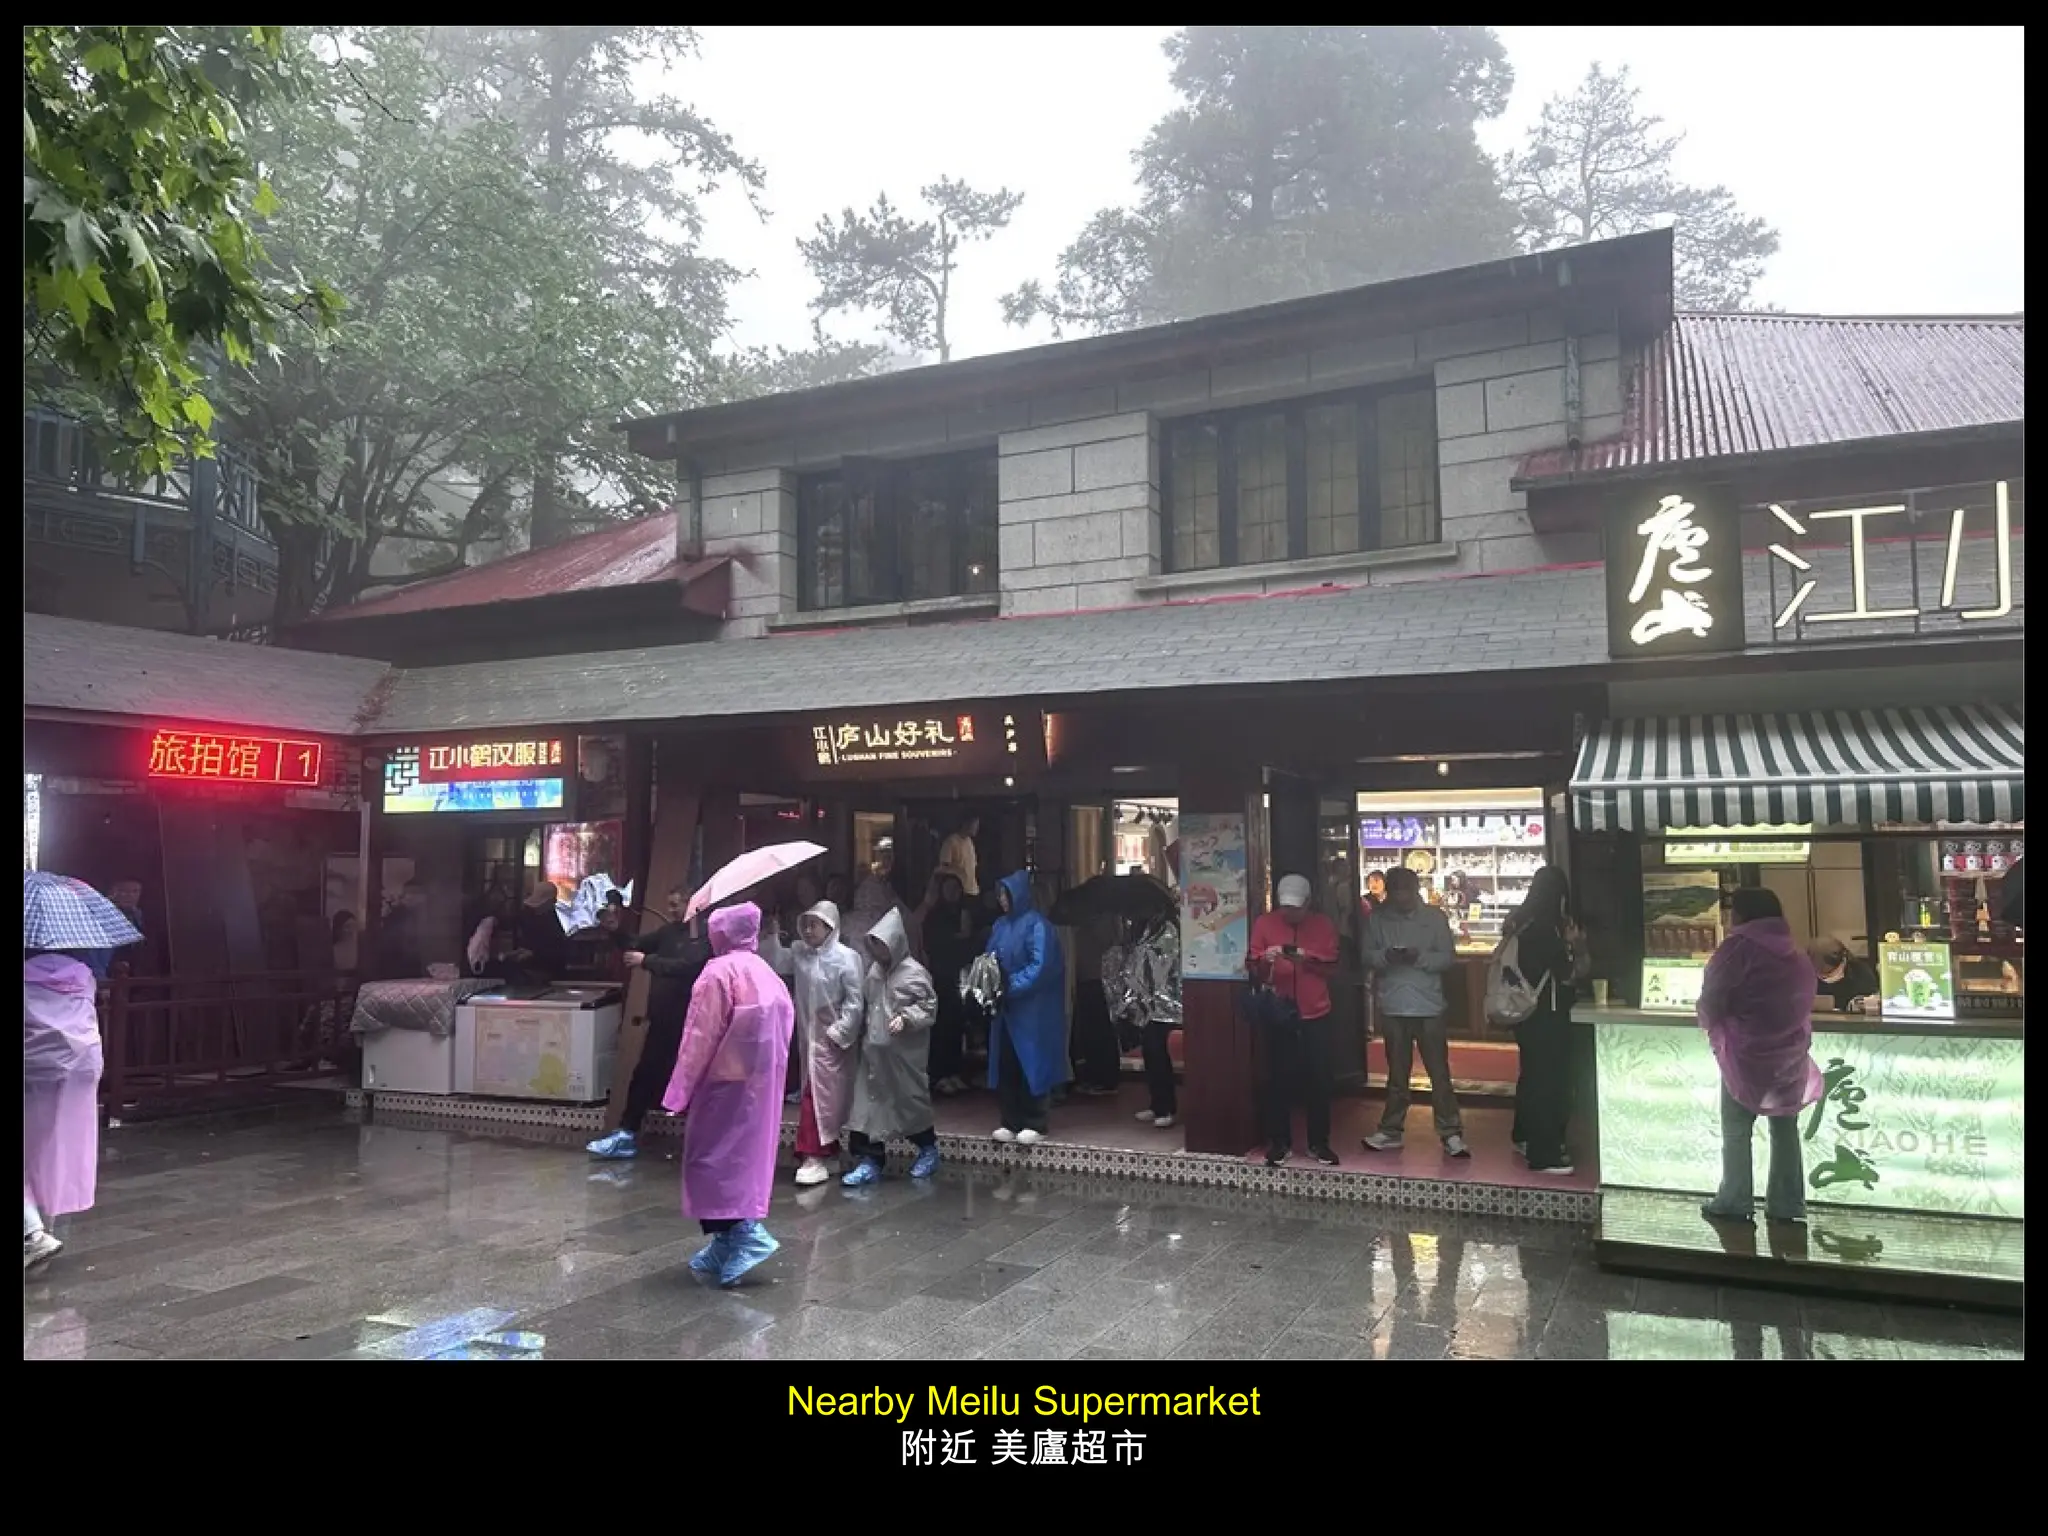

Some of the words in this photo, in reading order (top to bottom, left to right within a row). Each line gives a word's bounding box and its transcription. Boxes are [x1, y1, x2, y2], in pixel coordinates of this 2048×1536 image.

[836, 719, 955, 750] 庐山好礼
[149, 734, 261, 778] 旅拍馆
[299, 750, 311, 777] 1
